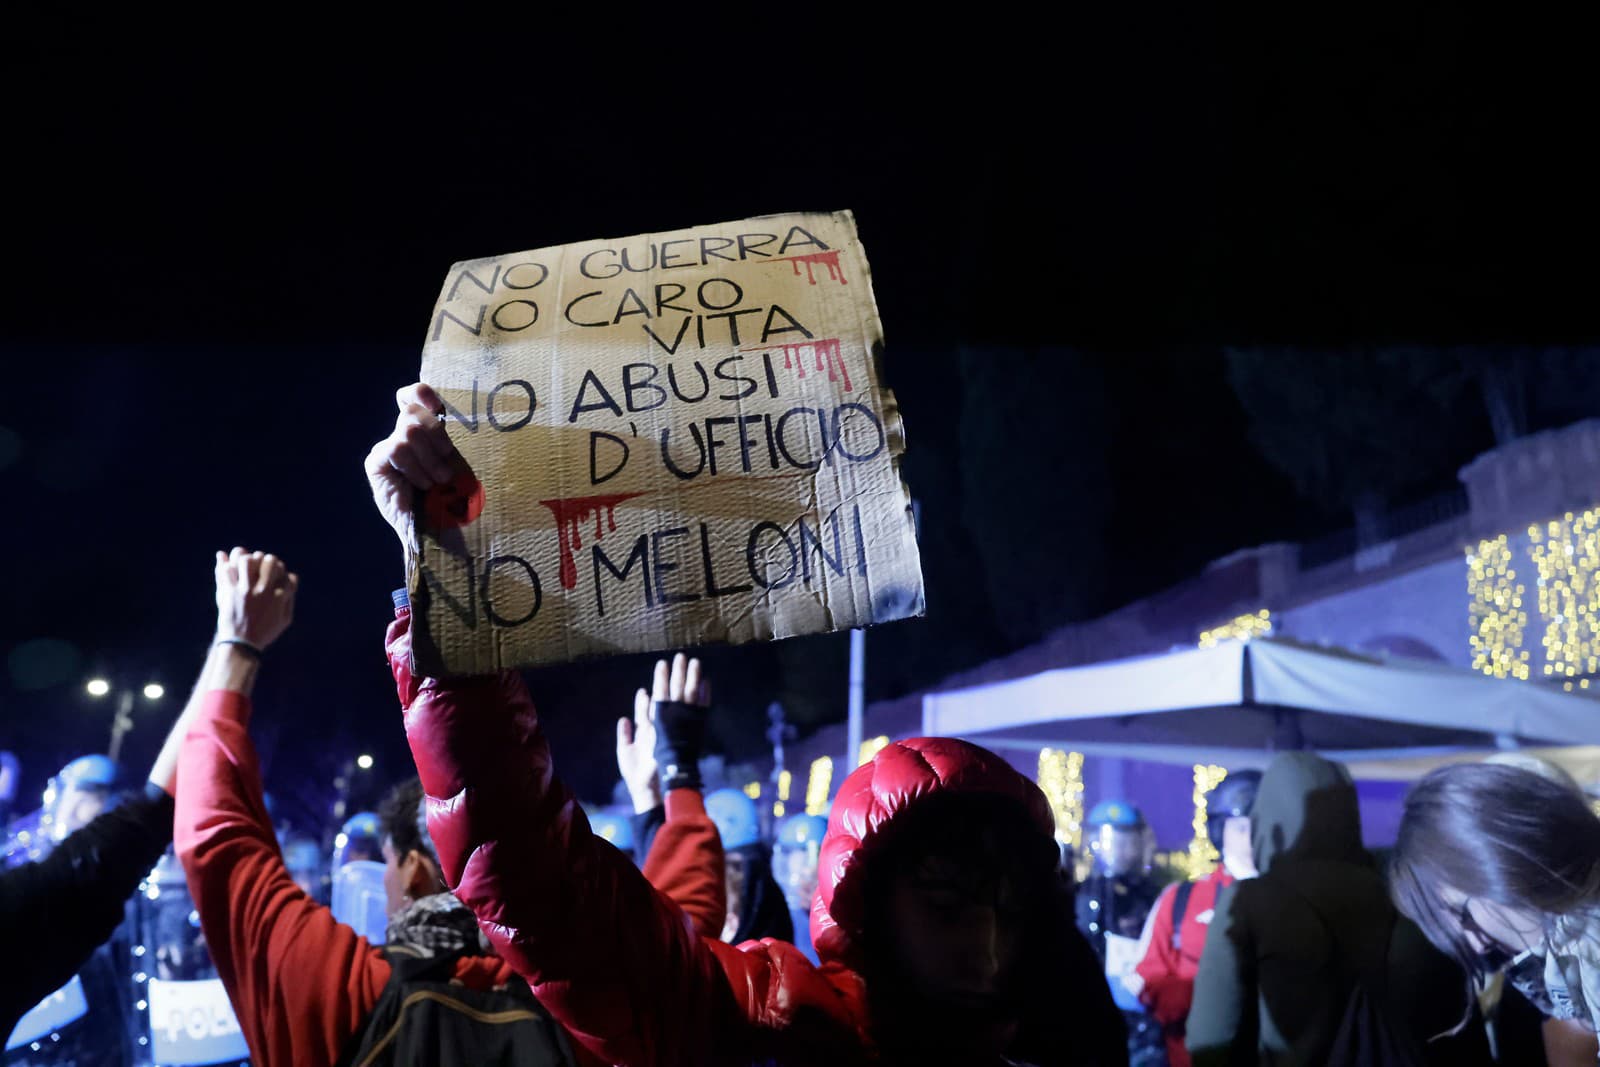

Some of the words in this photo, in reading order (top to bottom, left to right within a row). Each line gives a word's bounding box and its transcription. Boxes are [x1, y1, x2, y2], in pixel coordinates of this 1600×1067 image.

[446, 262, 548, 302] NO
[580, 225, 829, 280] GUERRA
[432, 300, 539, 341] NO
[564, 278, 744, 327] CARO
[642, 304, 814, 355] VITA
[568, 353, 780, 423] ABUSI
[589, 402, 884, 486] D'UFFICIO
[418, 554, 541, 631] NO
[591, 504, 869, 617] MELONI
